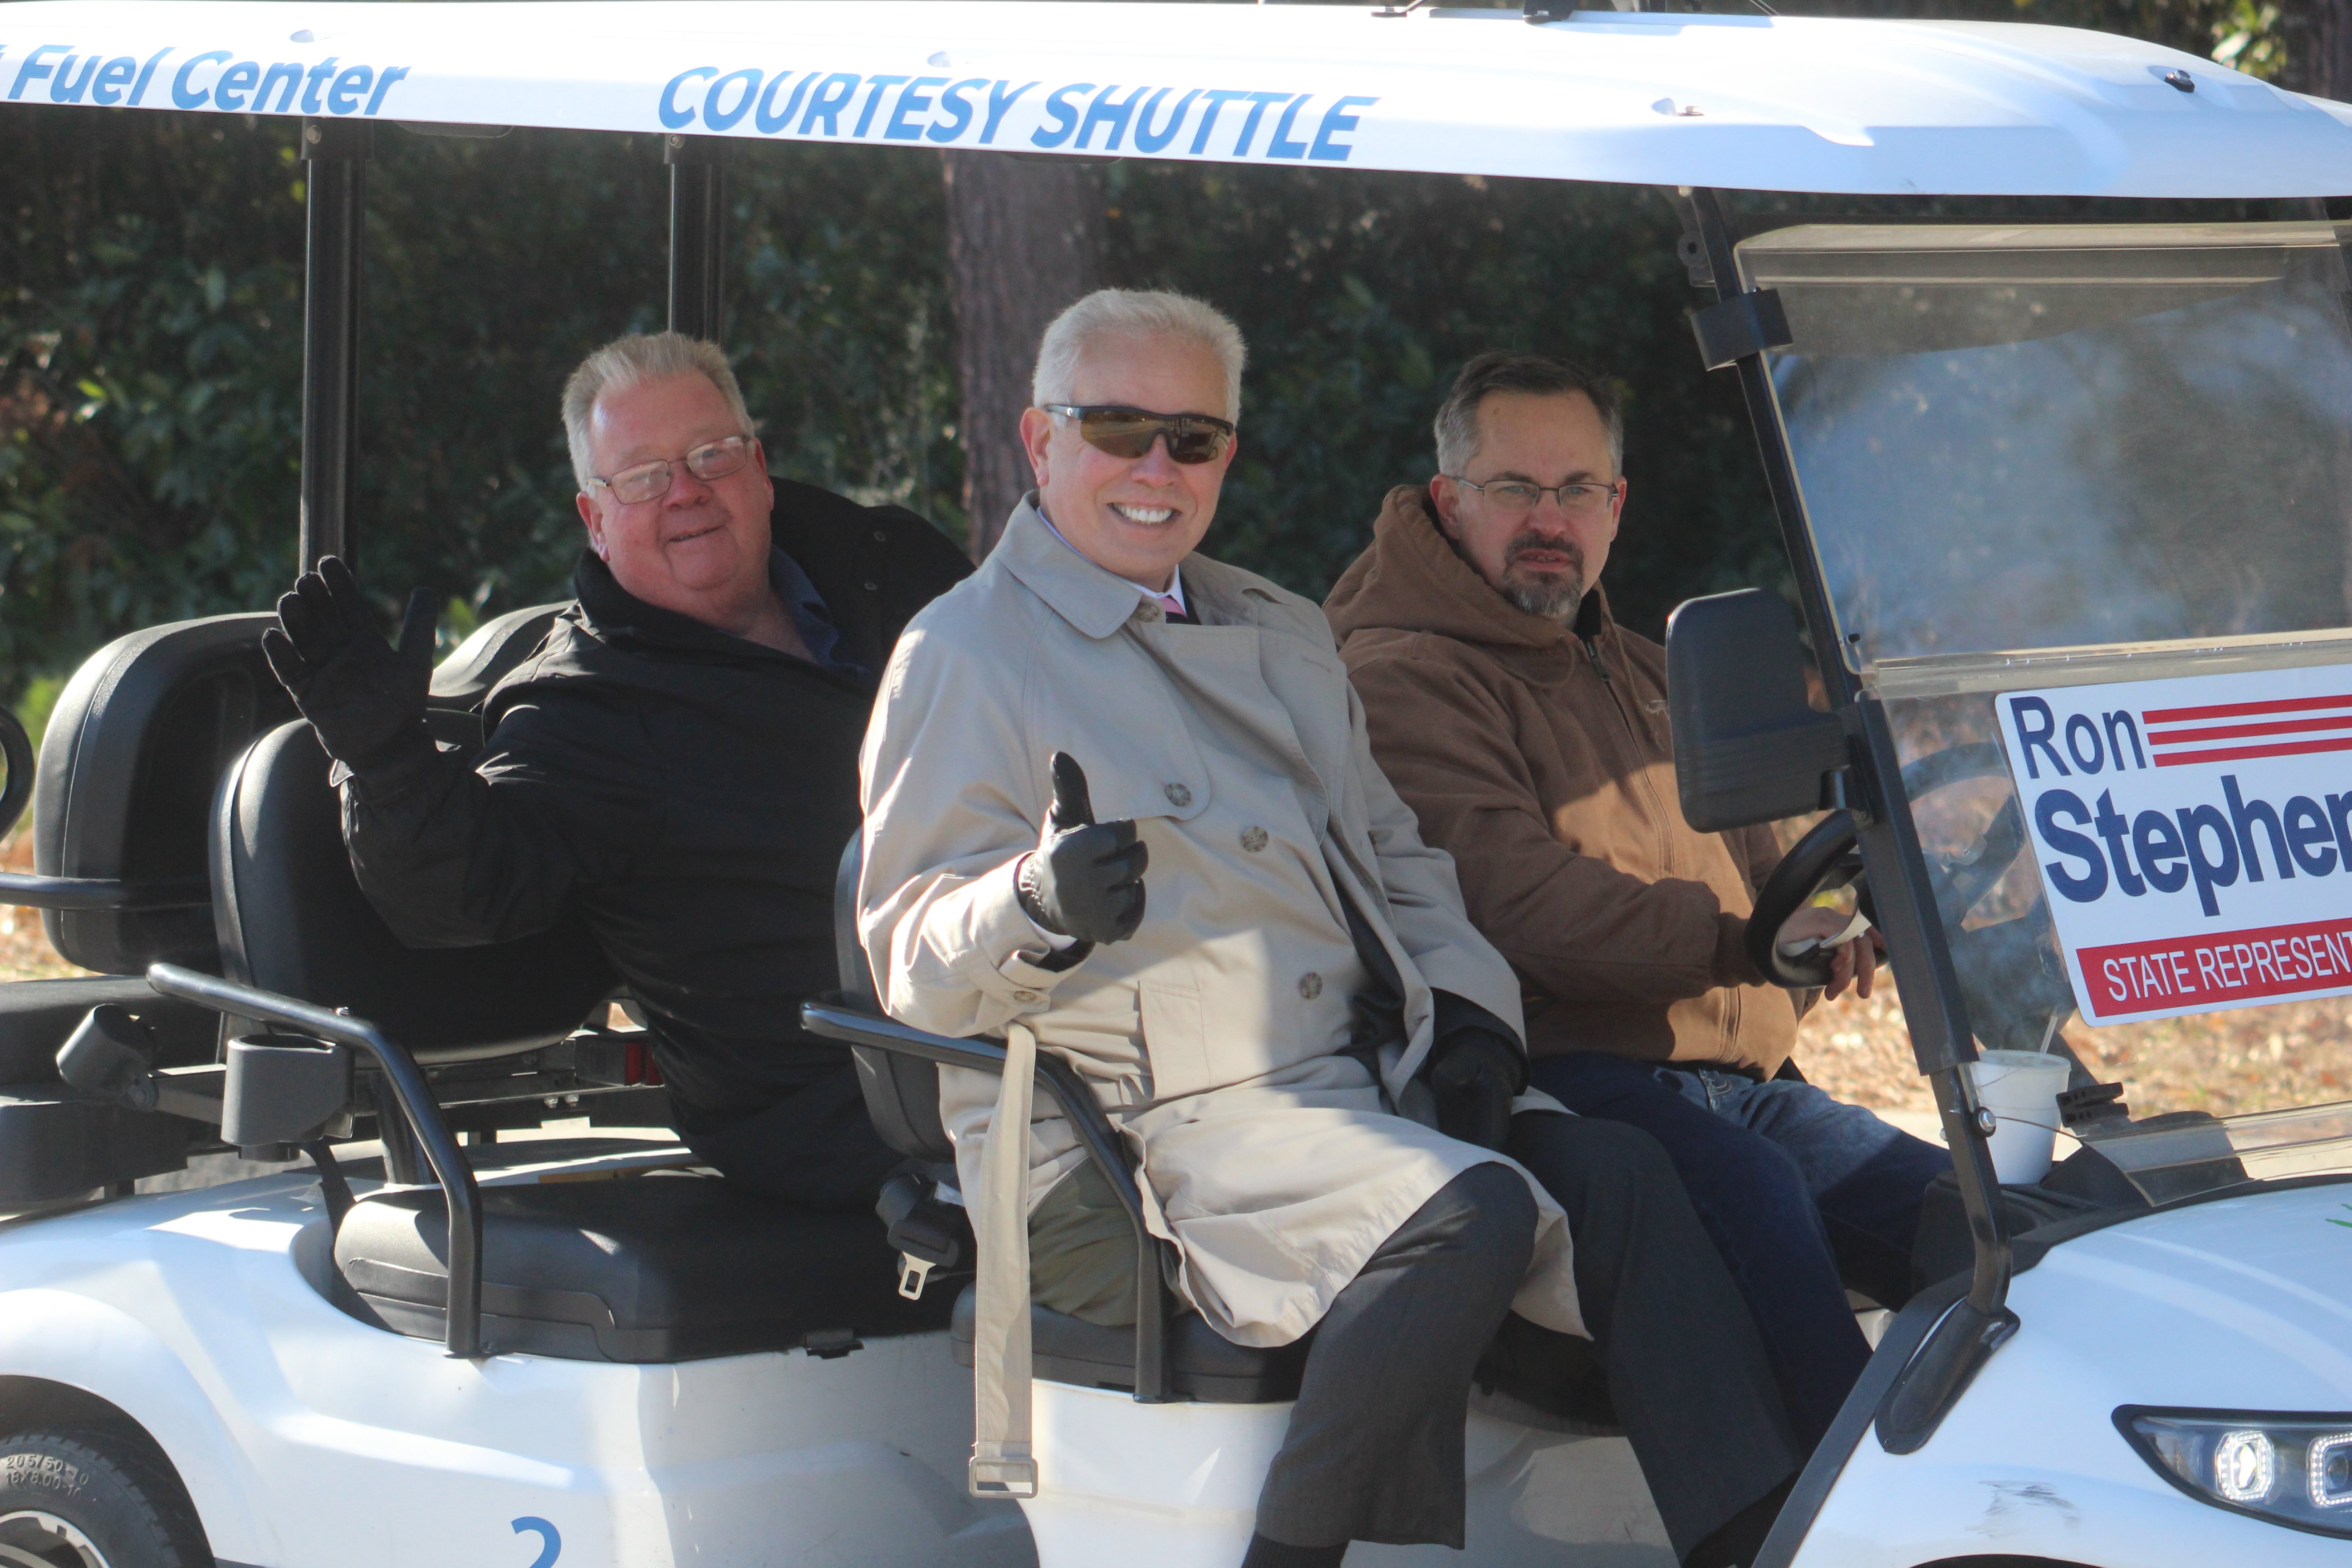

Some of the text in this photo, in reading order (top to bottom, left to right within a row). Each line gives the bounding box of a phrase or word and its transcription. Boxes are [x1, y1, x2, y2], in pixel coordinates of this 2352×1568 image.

[7, 44, 412, 115] Fuel Center
[658, 66, 1380, 162] COURTESY SHUTTLE
[2009, 696, 2147, 779] Ron
[2103, 951, 2196, 1002] STATE
[511, 1516, 561, 1568] 2
